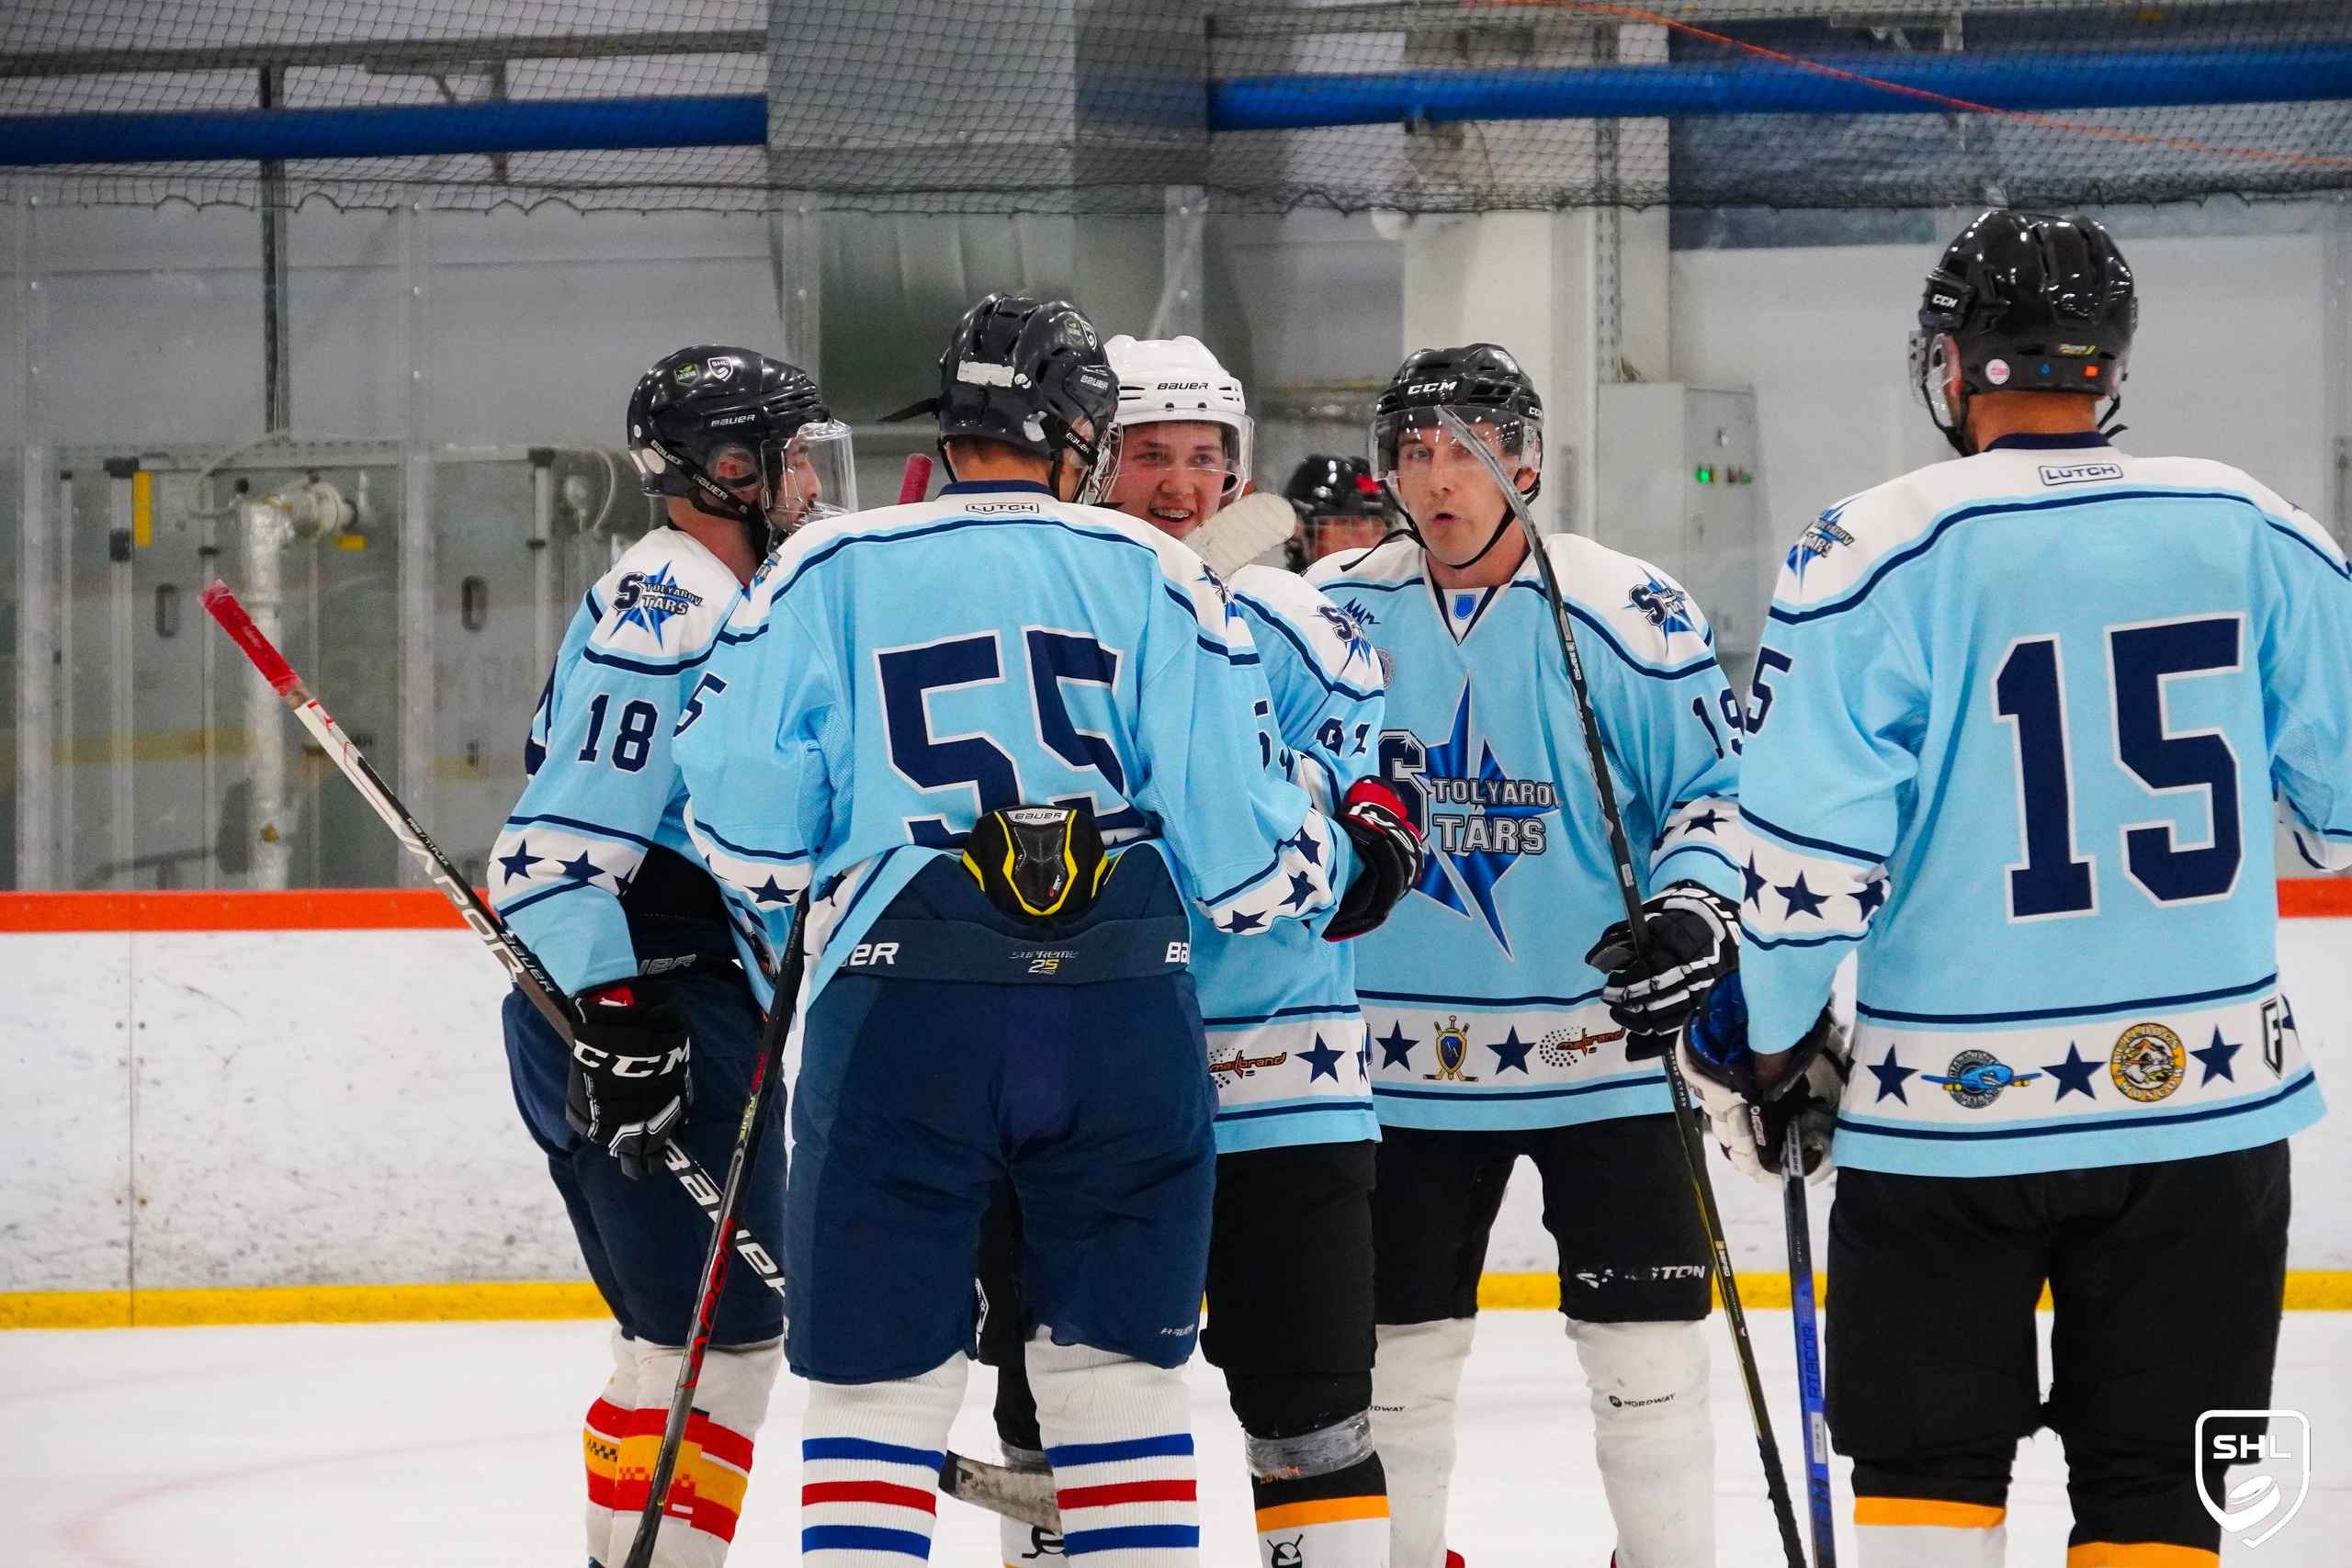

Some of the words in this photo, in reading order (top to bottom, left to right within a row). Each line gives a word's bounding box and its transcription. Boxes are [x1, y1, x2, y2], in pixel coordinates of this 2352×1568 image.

[1931, 293, 1959, 308] CCM
[1080, 374, 1109, 390] BAUER
[1157, 381, 1209, 391] BAUER
[1408, 380, 1457, 395] CCM
[710, 413, 755, 427] BAUER
[2045, 463, 2117, 481] LUTCH
[969, 503, 1036, 513] LUTCH
[578, 693, 658, 773] 18
[1691, 687, 1745, 761] 19
[876, 626, 1148, 847] 55
[1991, 611, 2247, 923] 15
[1014, 812, 1062, 820] BAUER
[395, 820, 525, 984] VAPOR
[500, 932, 554, 993] BAUER
[572, 1035, 691, 1078] CCM
[2112, 1026, 2180, 1064] BULLDOGS
[1209, 1050, 1287, 1079] mailbrand
[2117, 1066, 2185, 1100] MOSCOW
[1369, 1404, 1405, 1413] RDWAY
[1623, 1393, 1676, 1407] NORDWAY
